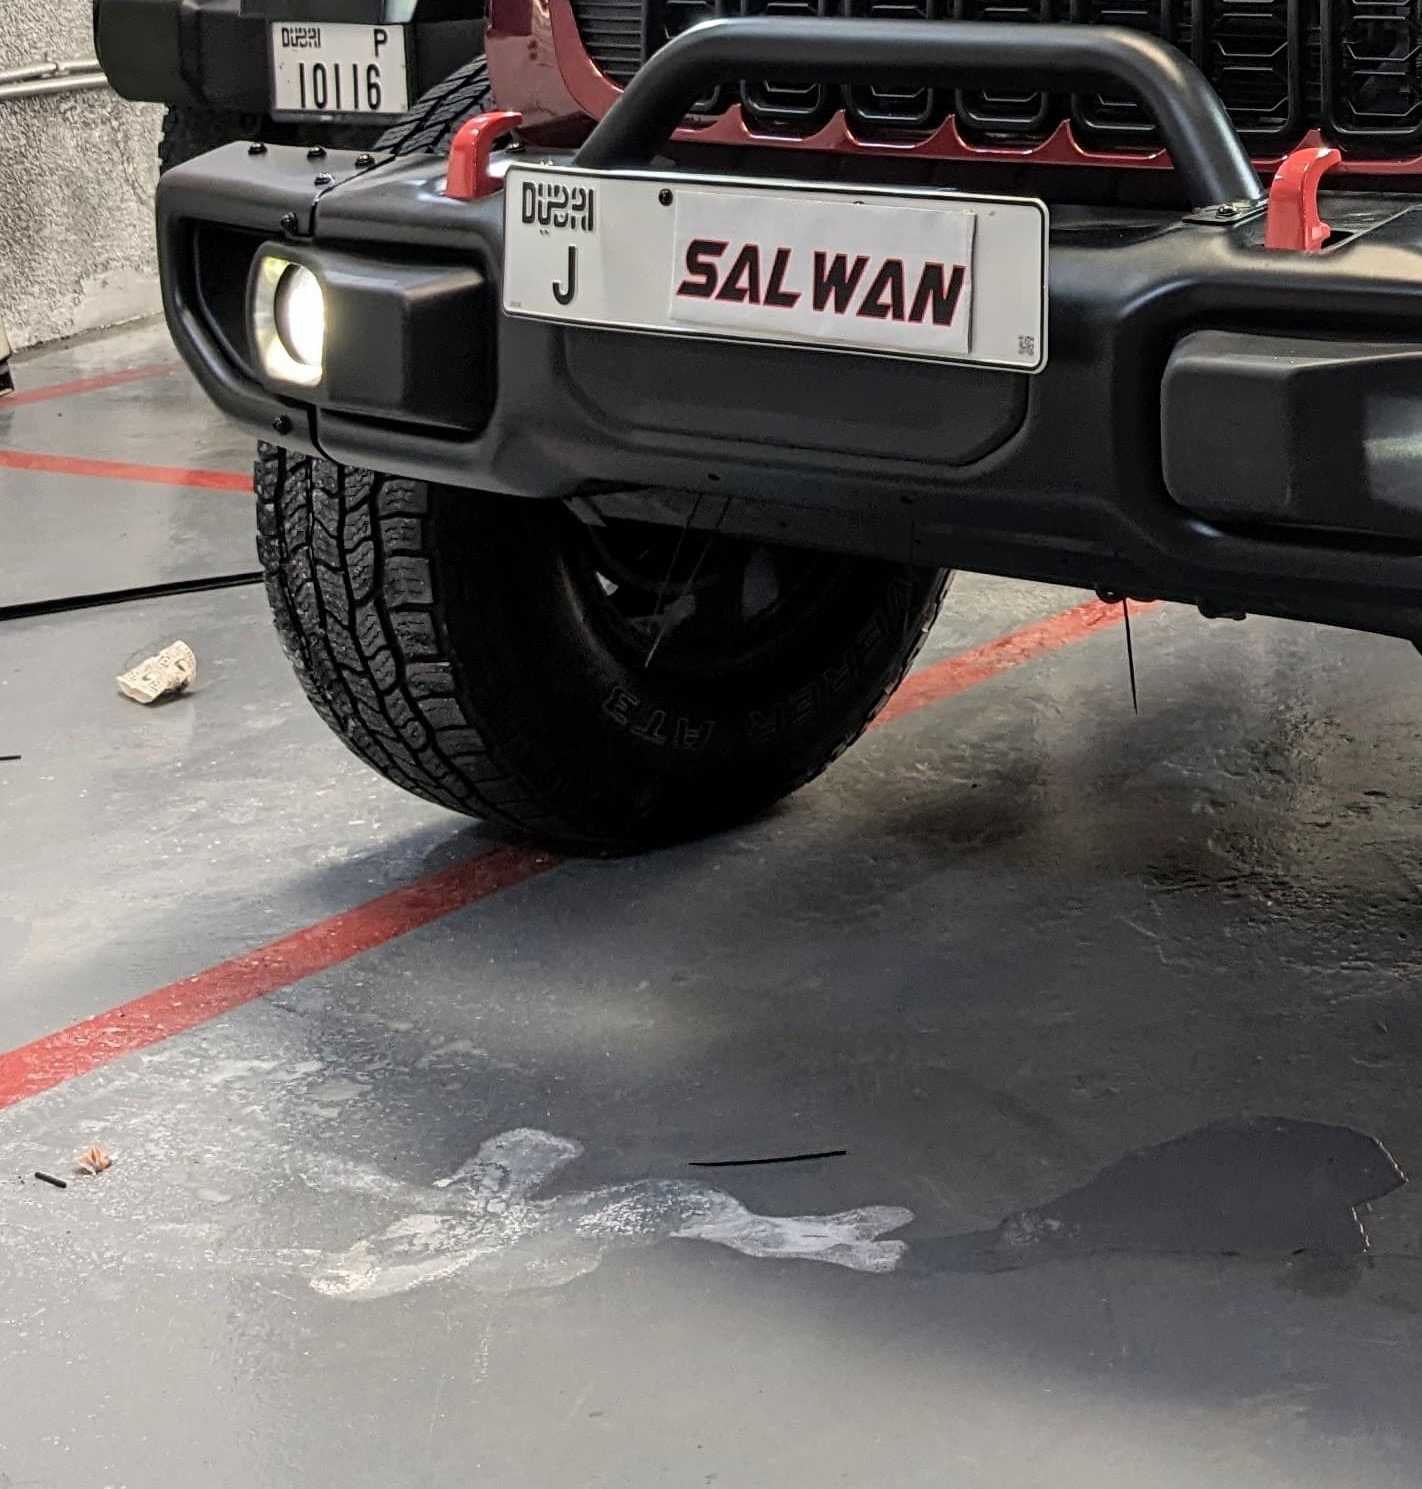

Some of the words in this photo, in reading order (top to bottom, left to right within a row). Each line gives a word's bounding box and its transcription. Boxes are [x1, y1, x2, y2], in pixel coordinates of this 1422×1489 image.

[373, 28, 388, 58] P
[299, 62, 382, 110] 10116
[552, 246, 576, 305] J
[677, 239, 966, 326] SALWAN
